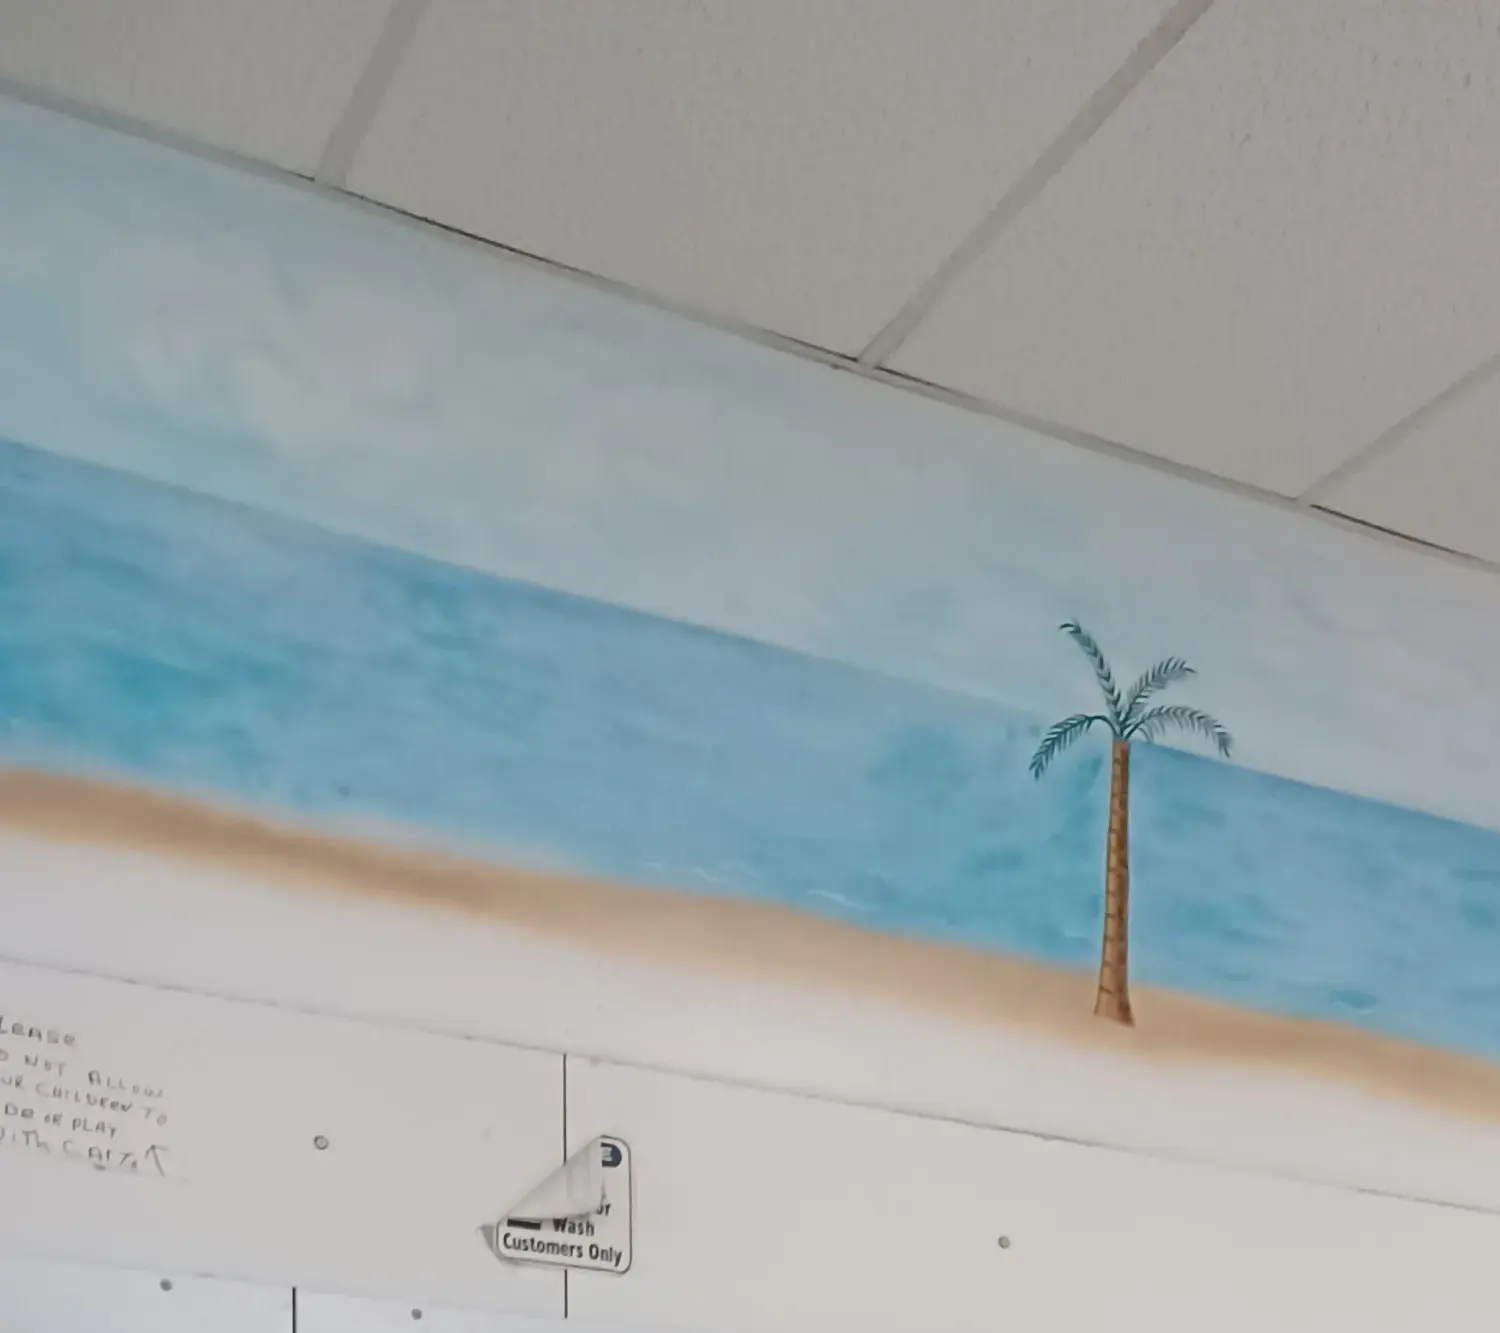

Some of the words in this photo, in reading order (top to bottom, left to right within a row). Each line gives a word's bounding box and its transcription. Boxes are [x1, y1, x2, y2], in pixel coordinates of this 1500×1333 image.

[553, 1218, 595, 1237] Wash
[503, 1233, 584, 1259] Customers
[589, 1244, 623, 1267] Only
